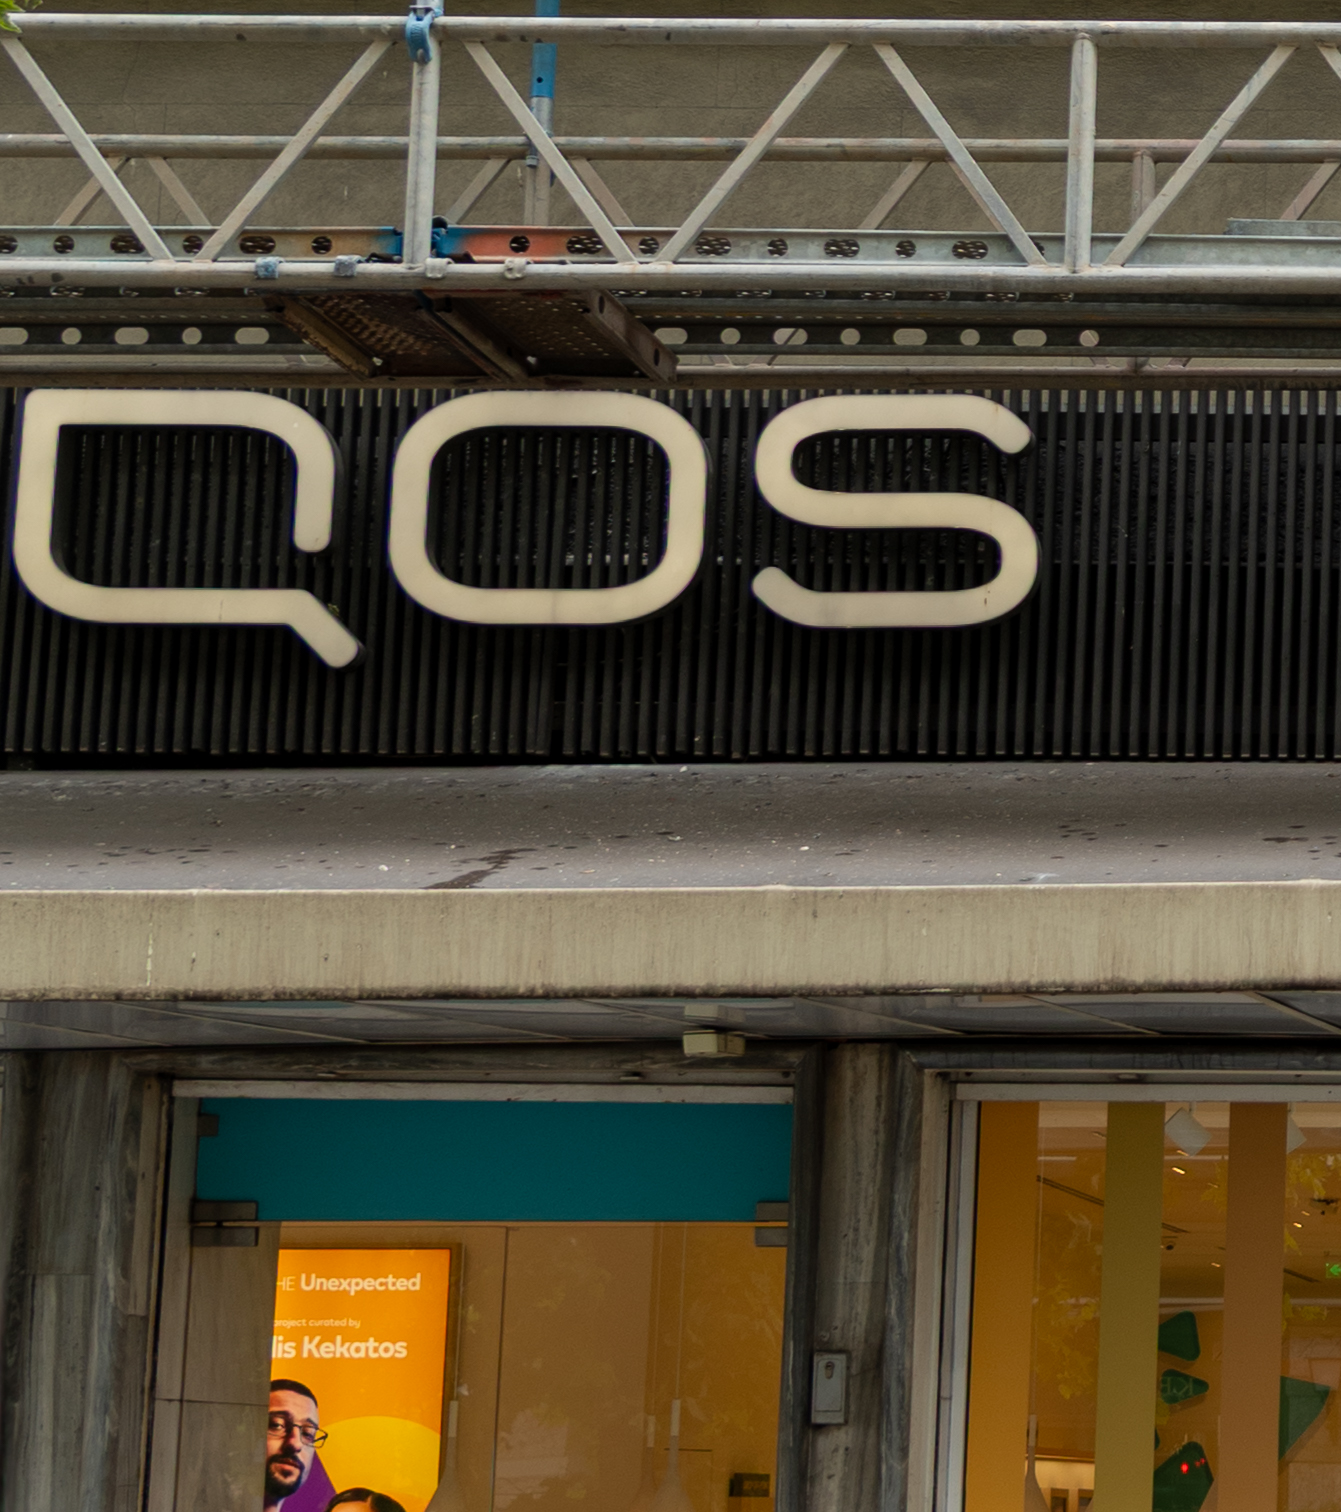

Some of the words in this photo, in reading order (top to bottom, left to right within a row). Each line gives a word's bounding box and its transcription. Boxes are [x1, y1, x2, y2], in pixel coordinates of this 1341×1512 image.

[14, 388, 1040, 668] QOS
[276, 1276, 296, 1291] HE
[300, 1272, 421, 1296] Unexpected
[308, 1317, 346, 1327] curated
[348, 1317, 361, 1329] by
[272, 1335, 297, 1359] lis
[302, 1334, 408, 1359] Kekatos
